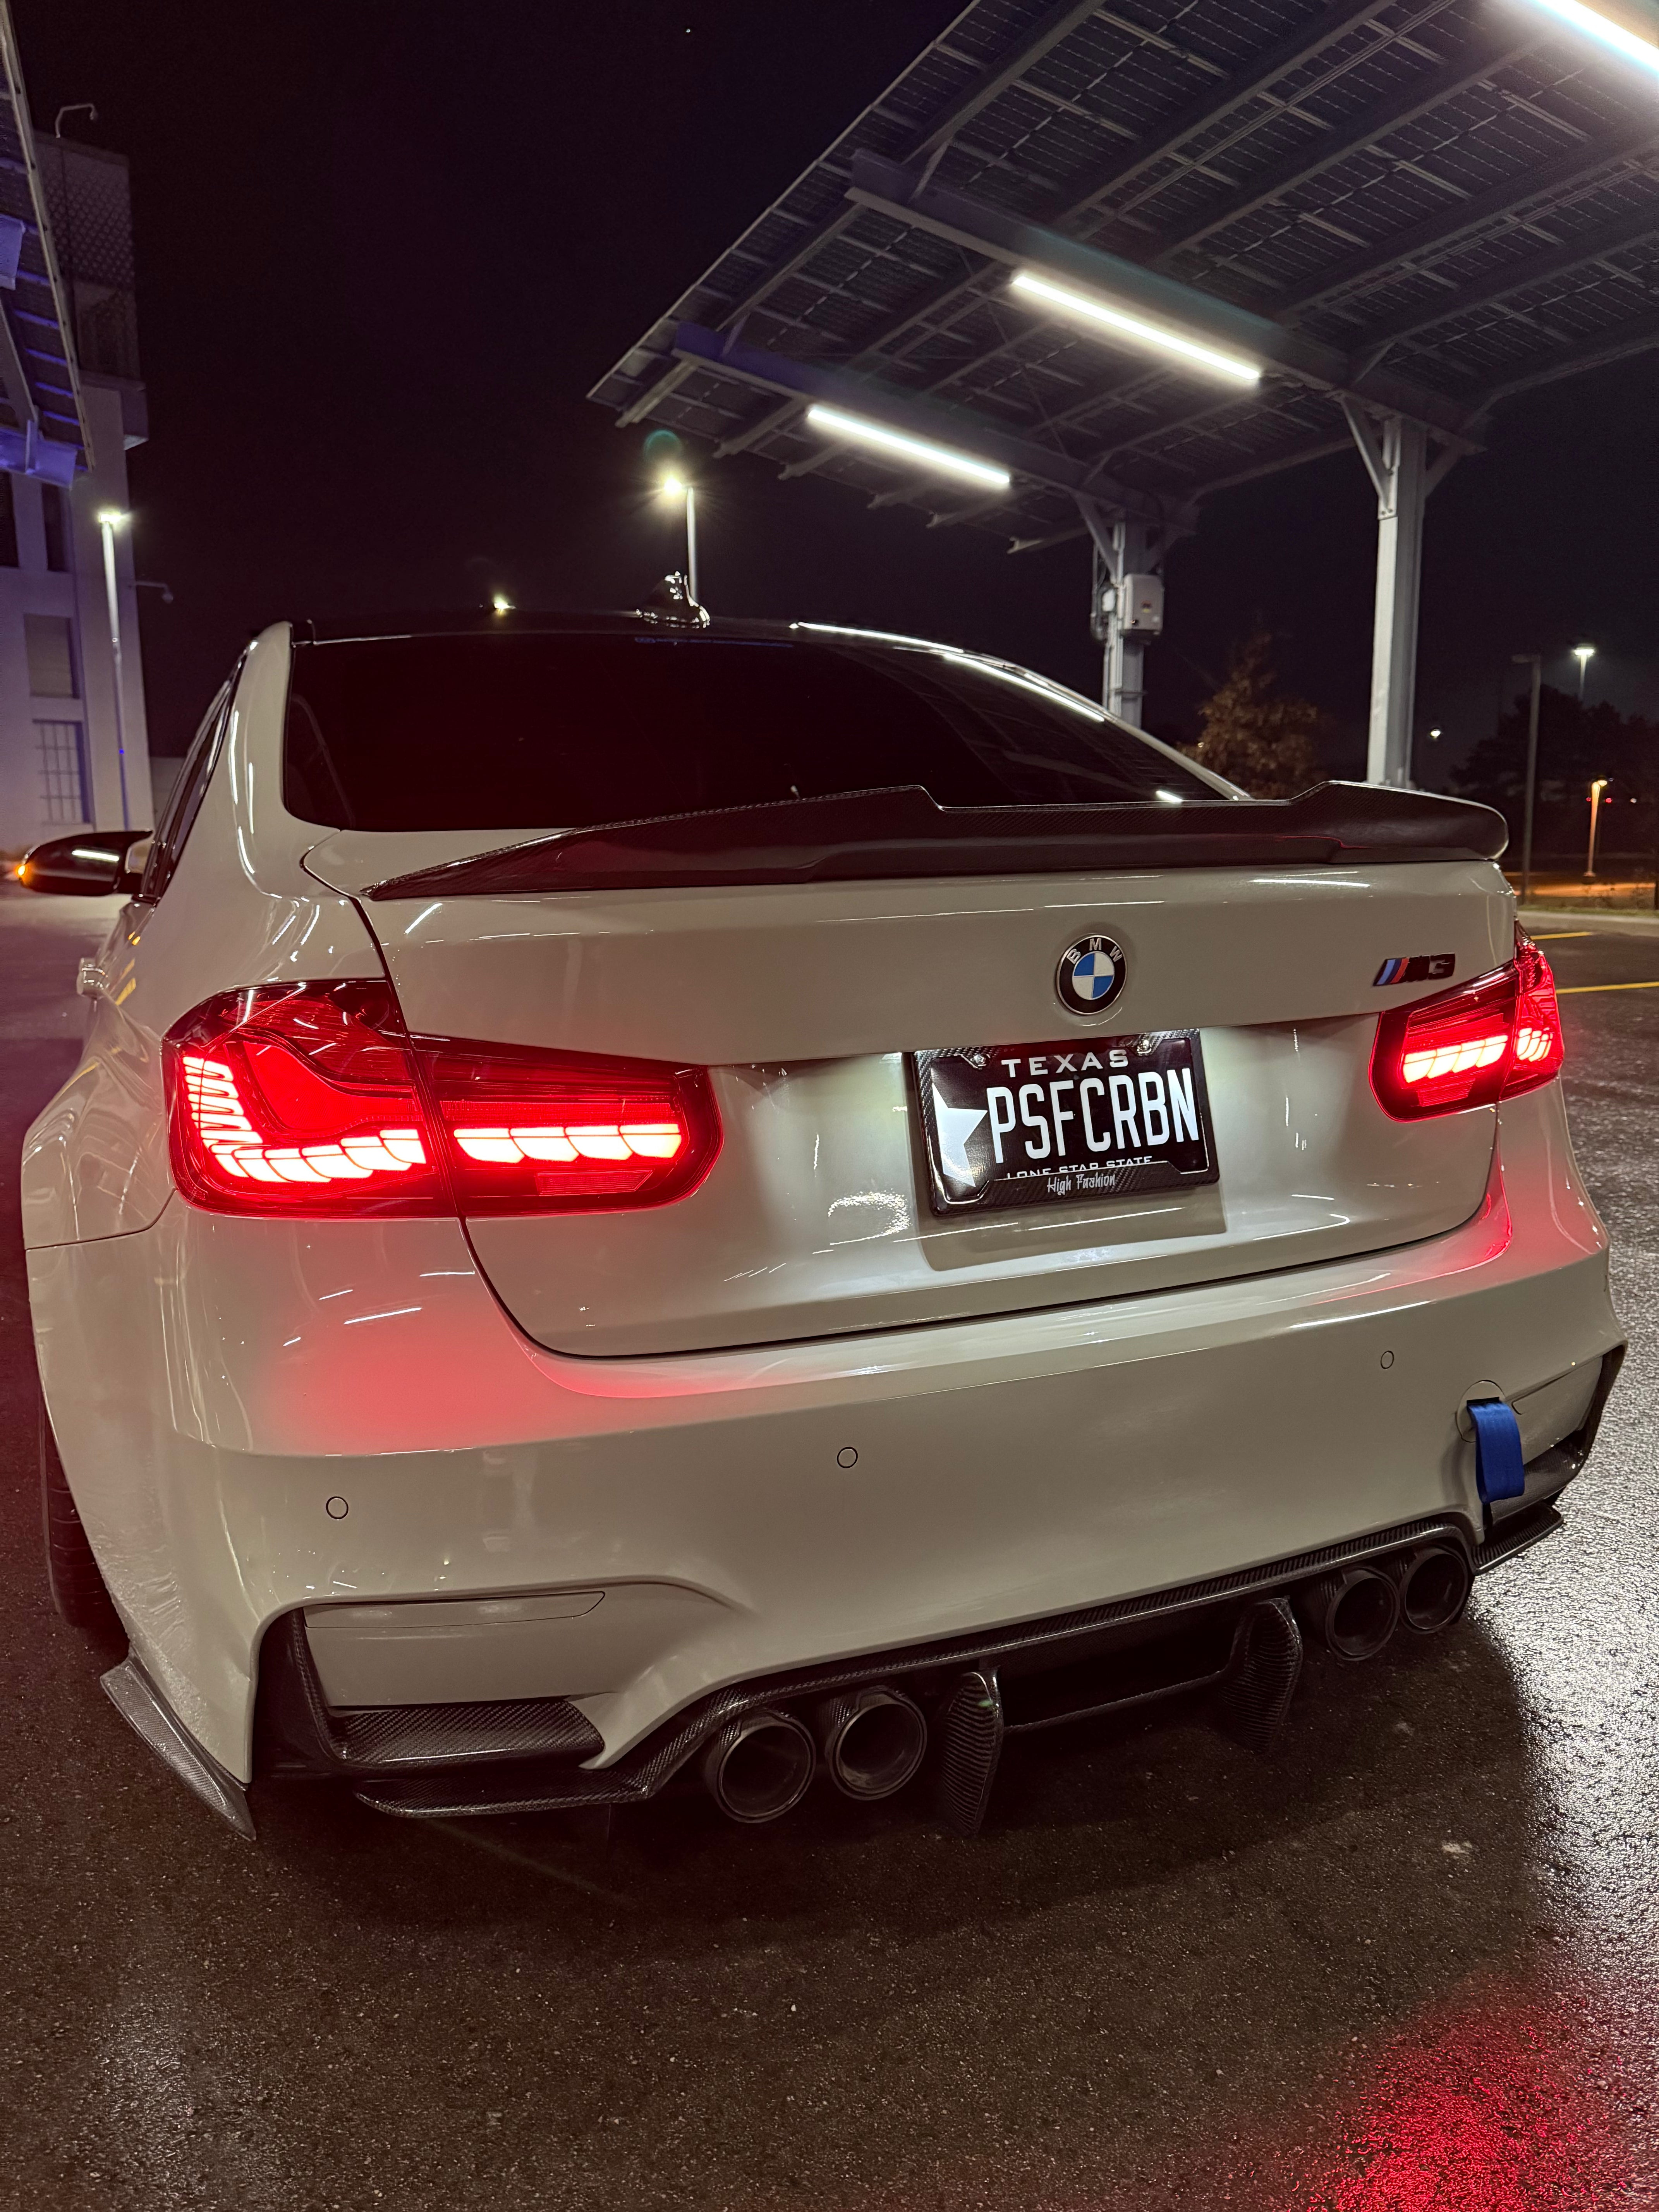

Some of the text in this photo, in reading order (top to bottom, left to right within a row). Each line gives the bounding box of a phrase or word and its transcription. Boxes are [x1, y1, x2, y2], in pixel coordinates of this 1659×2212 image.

[1066, 938, 1122, 964] BMW
[1393, 952, 1455, 983] M3
[1001, 1049, 1128, 1078] TEXAS
[987, 1068, 1199, 1163] PSFCRBN
[1047, 1171, 1116, 1196] High Fashion
